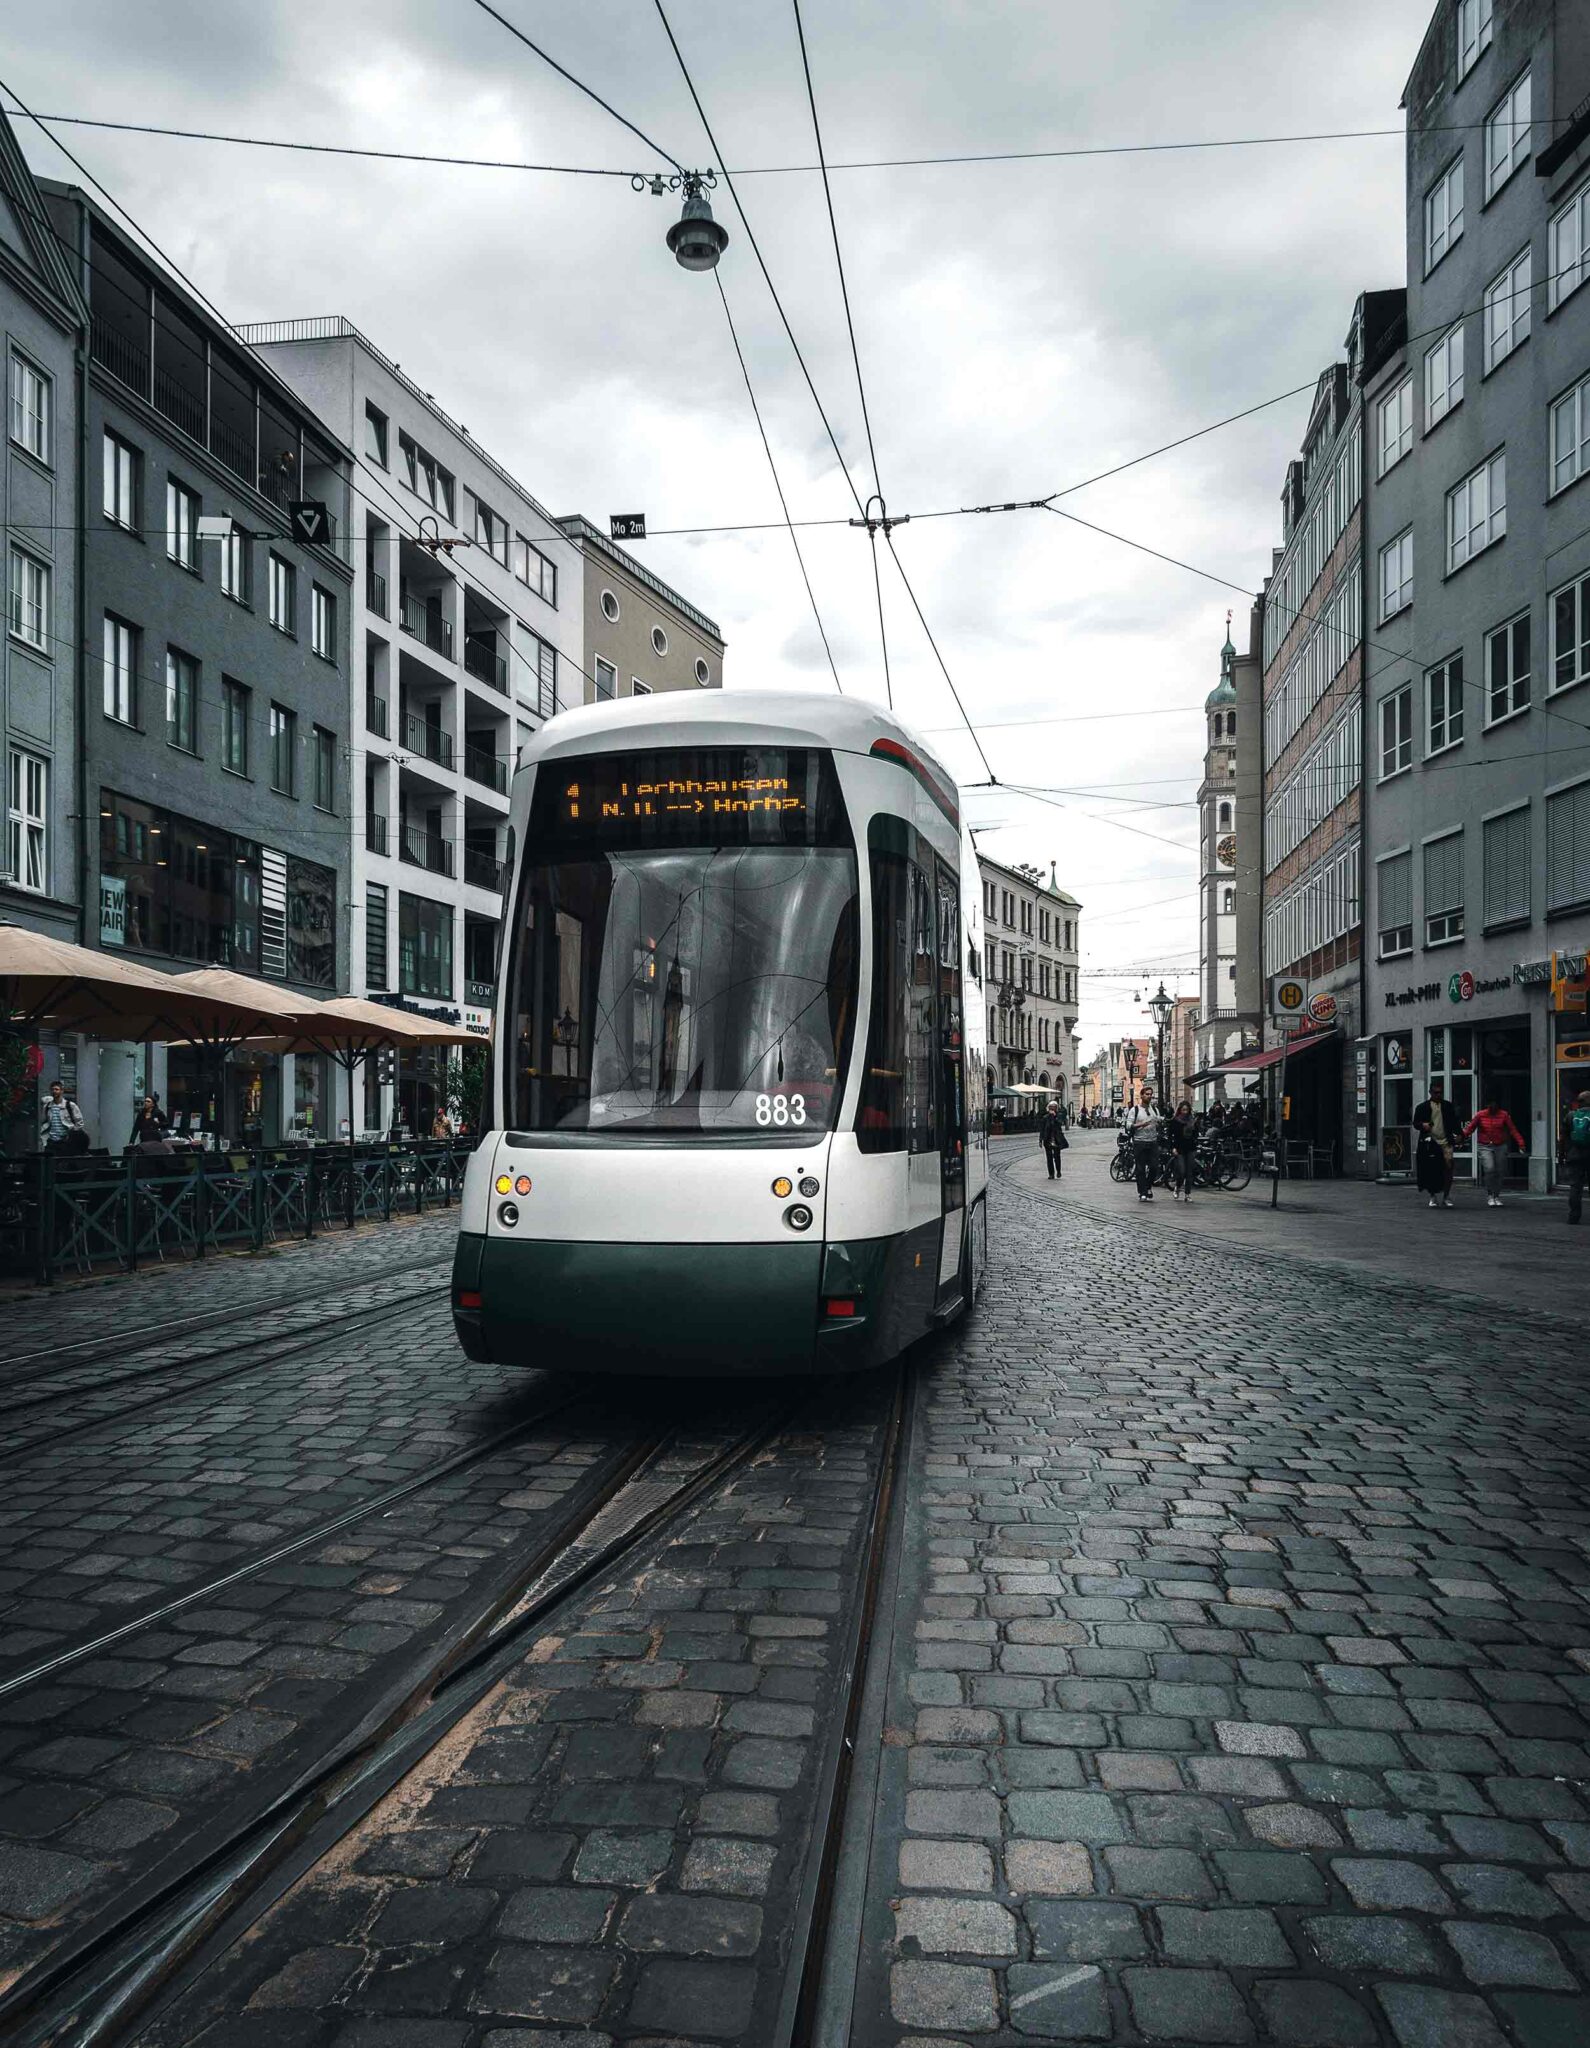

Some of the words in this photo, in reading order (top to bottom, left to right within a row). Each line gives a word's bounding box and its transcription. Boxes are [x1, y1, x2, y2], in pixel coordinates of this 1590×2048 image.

[612, 521, 626, 535] Mo
[629, 520, 645, 534] 2m
[471, 983, 491, 997] KDM
[1285, 988, 1297, 1004] H
[1312, 996, 1336, 1010] BURGER
[1313, 1002, 1337, 1016] KING
[756, 1093, 806, 1126] 883
